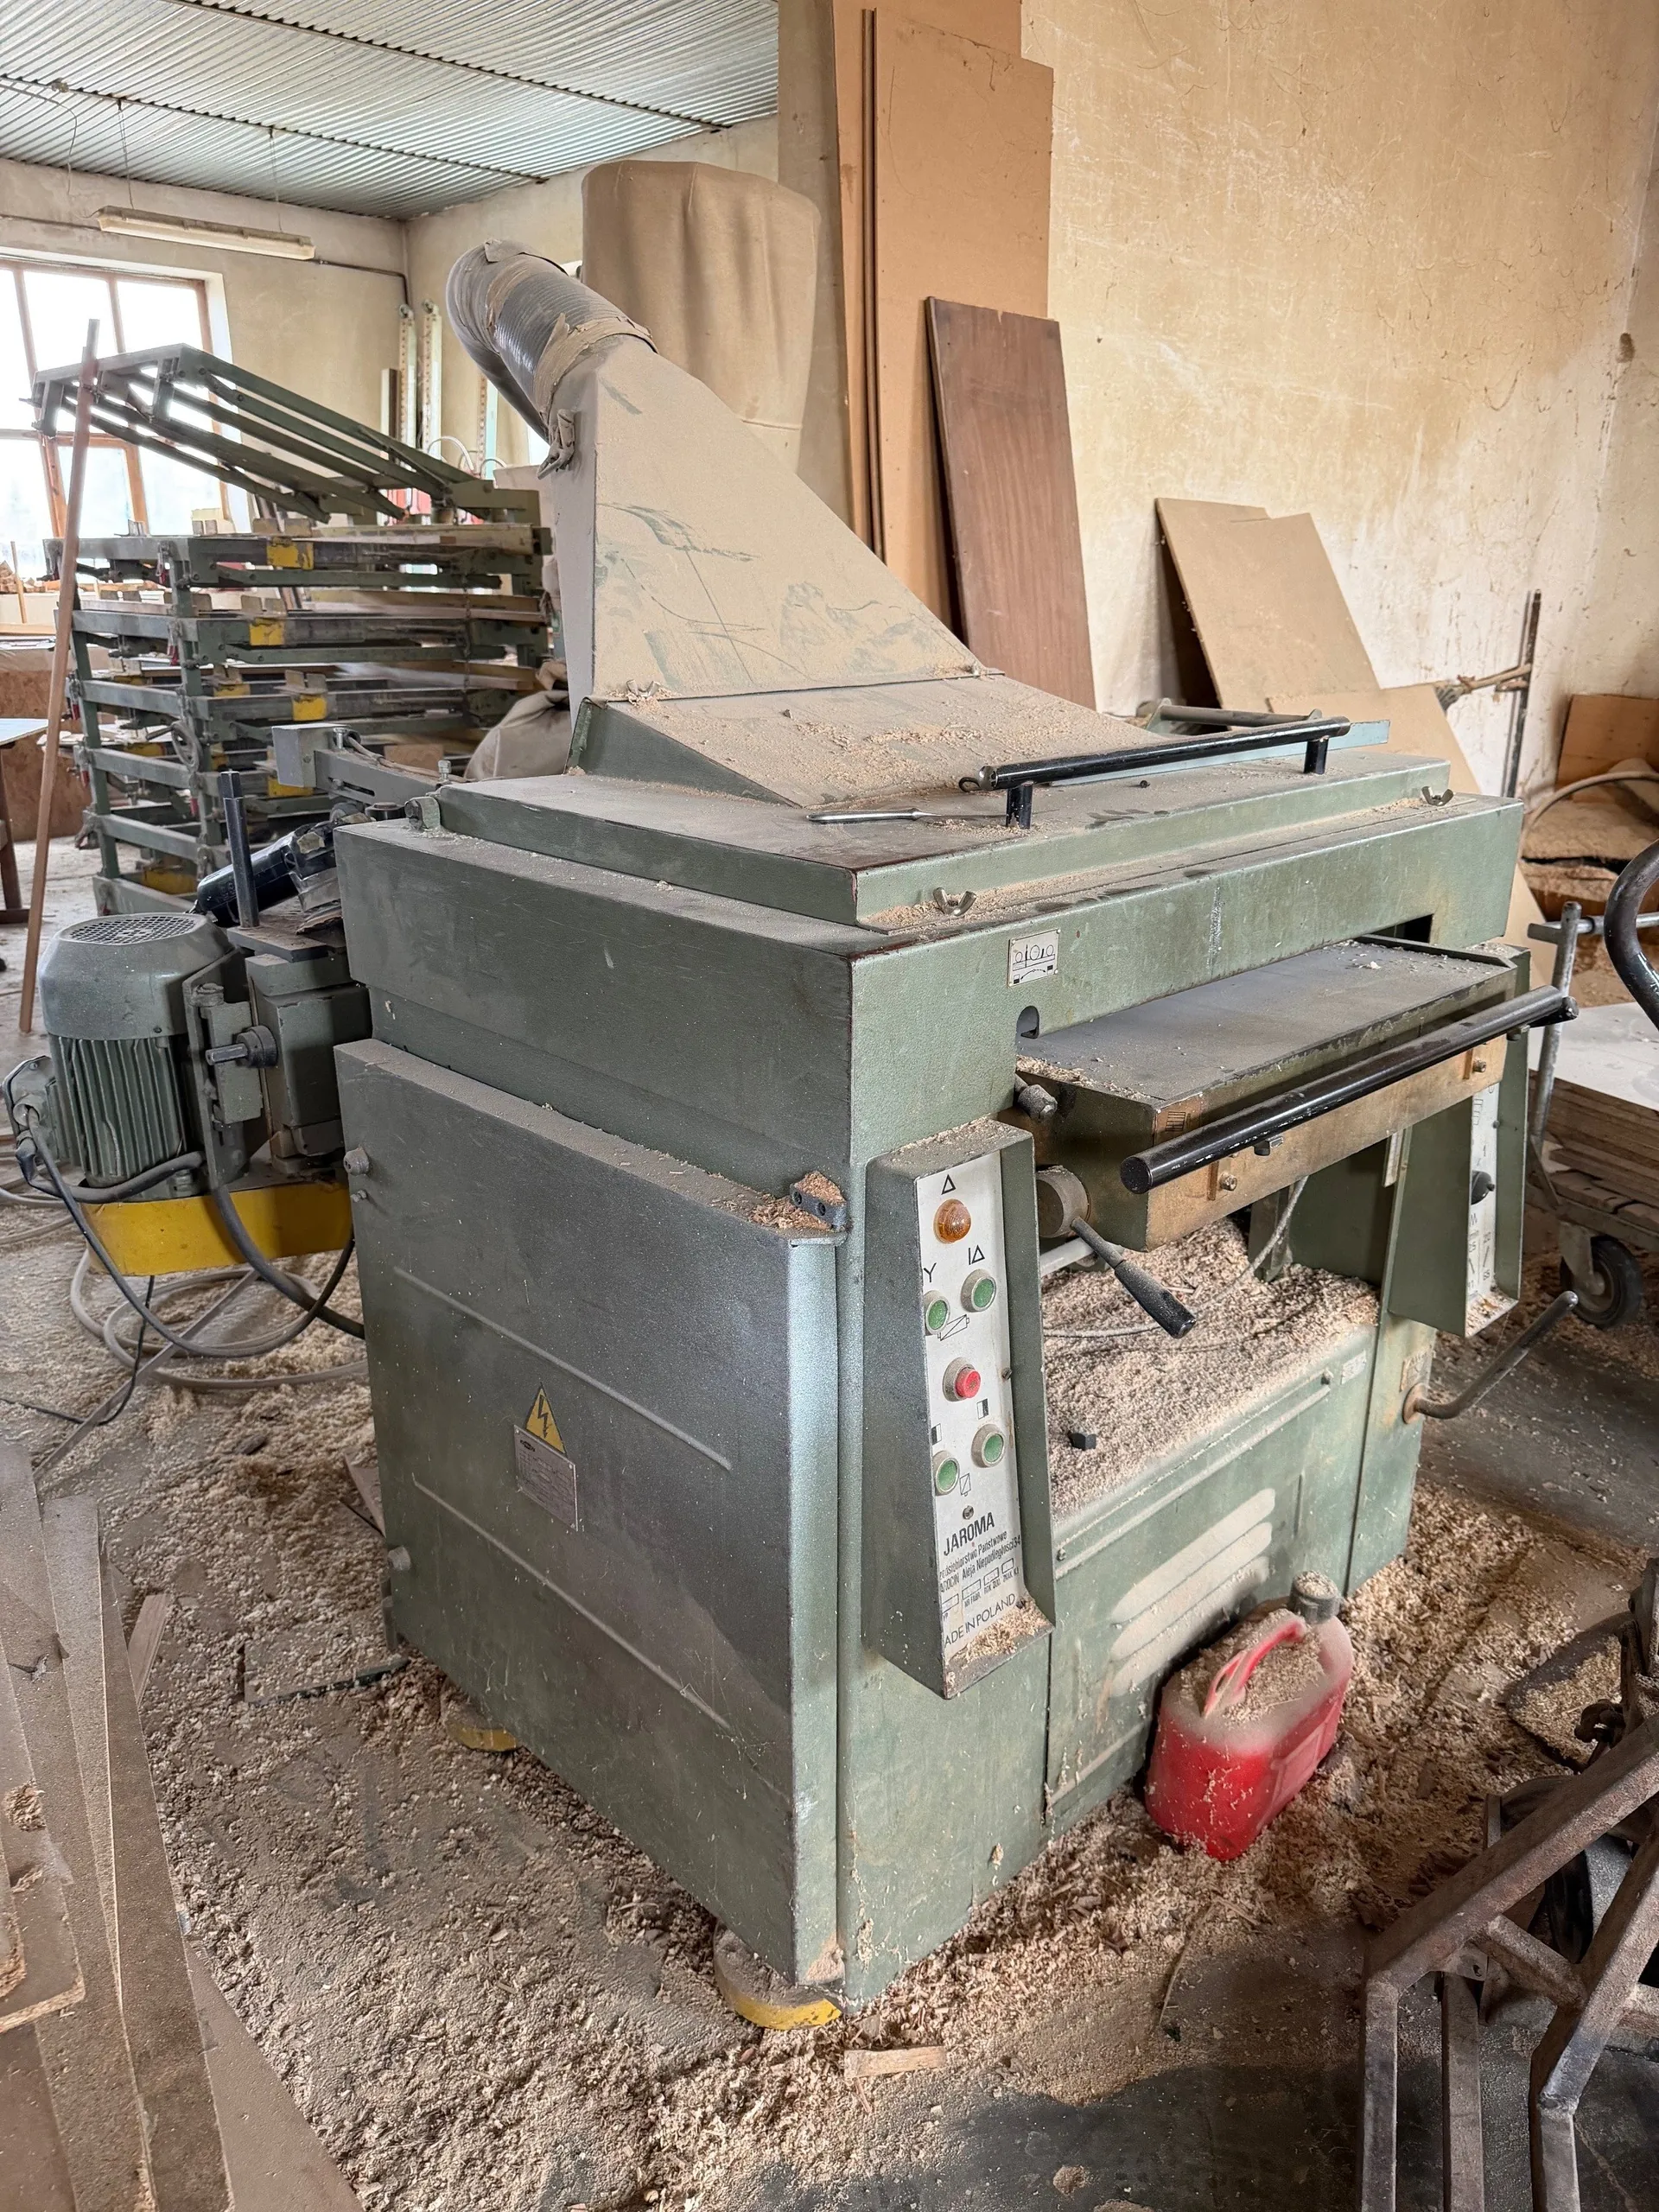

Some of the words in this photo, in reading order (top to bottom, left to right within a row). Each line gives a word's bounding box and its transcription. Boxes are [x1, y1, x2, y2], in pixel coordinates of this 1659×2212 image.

[944, 1511, 995, 1556] JAROMA
[962, 1564, 976, 1580] Aleja
[944, 1624, 964, 1649] ADE
[965, 1616, 976, 1633] IN
[977, 1592, 1015, 1627] POLAND
